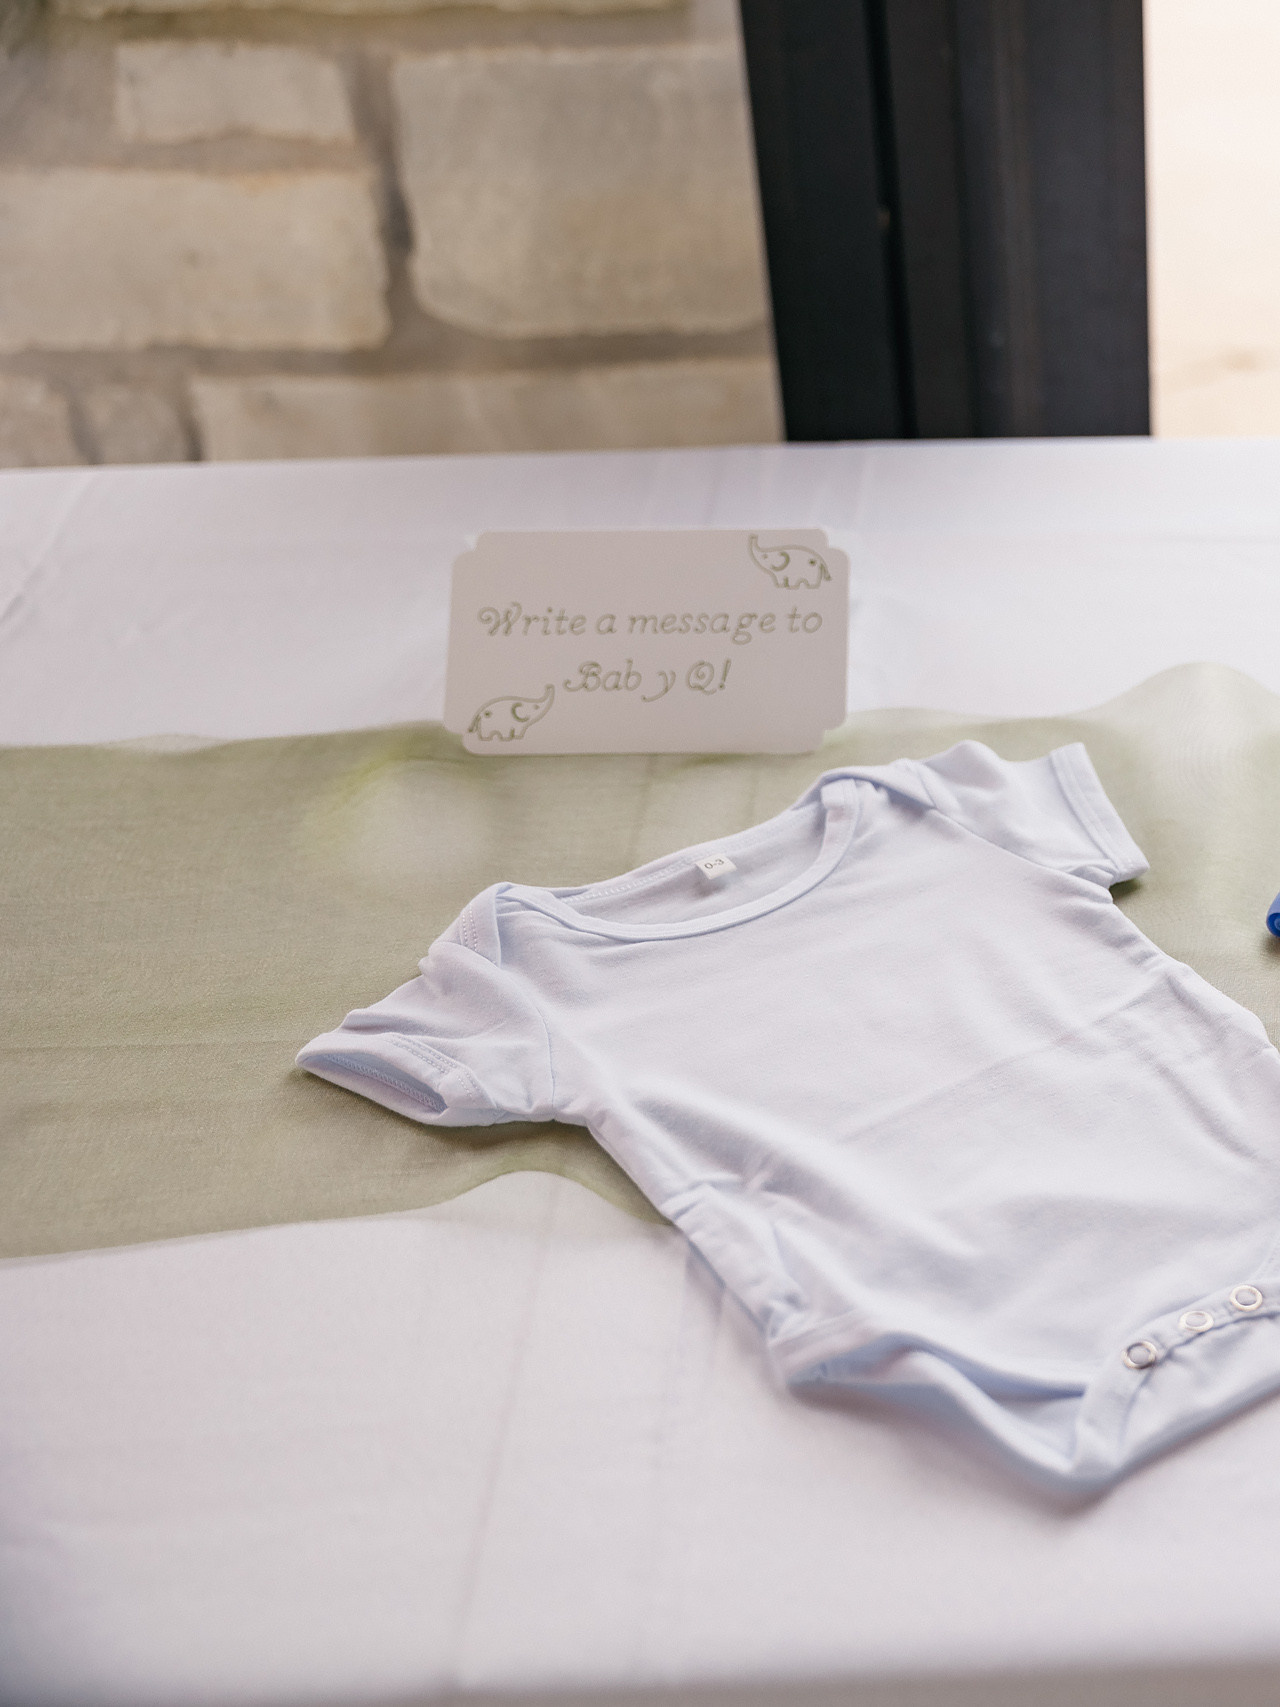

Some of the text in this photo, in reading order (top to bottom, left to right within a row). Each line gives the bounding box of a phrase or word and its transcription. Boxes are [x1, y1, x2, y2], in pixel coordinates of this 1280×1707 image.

[478, 602, 823, 645] Write a message to
[686, 658, 732, 694] Q!
